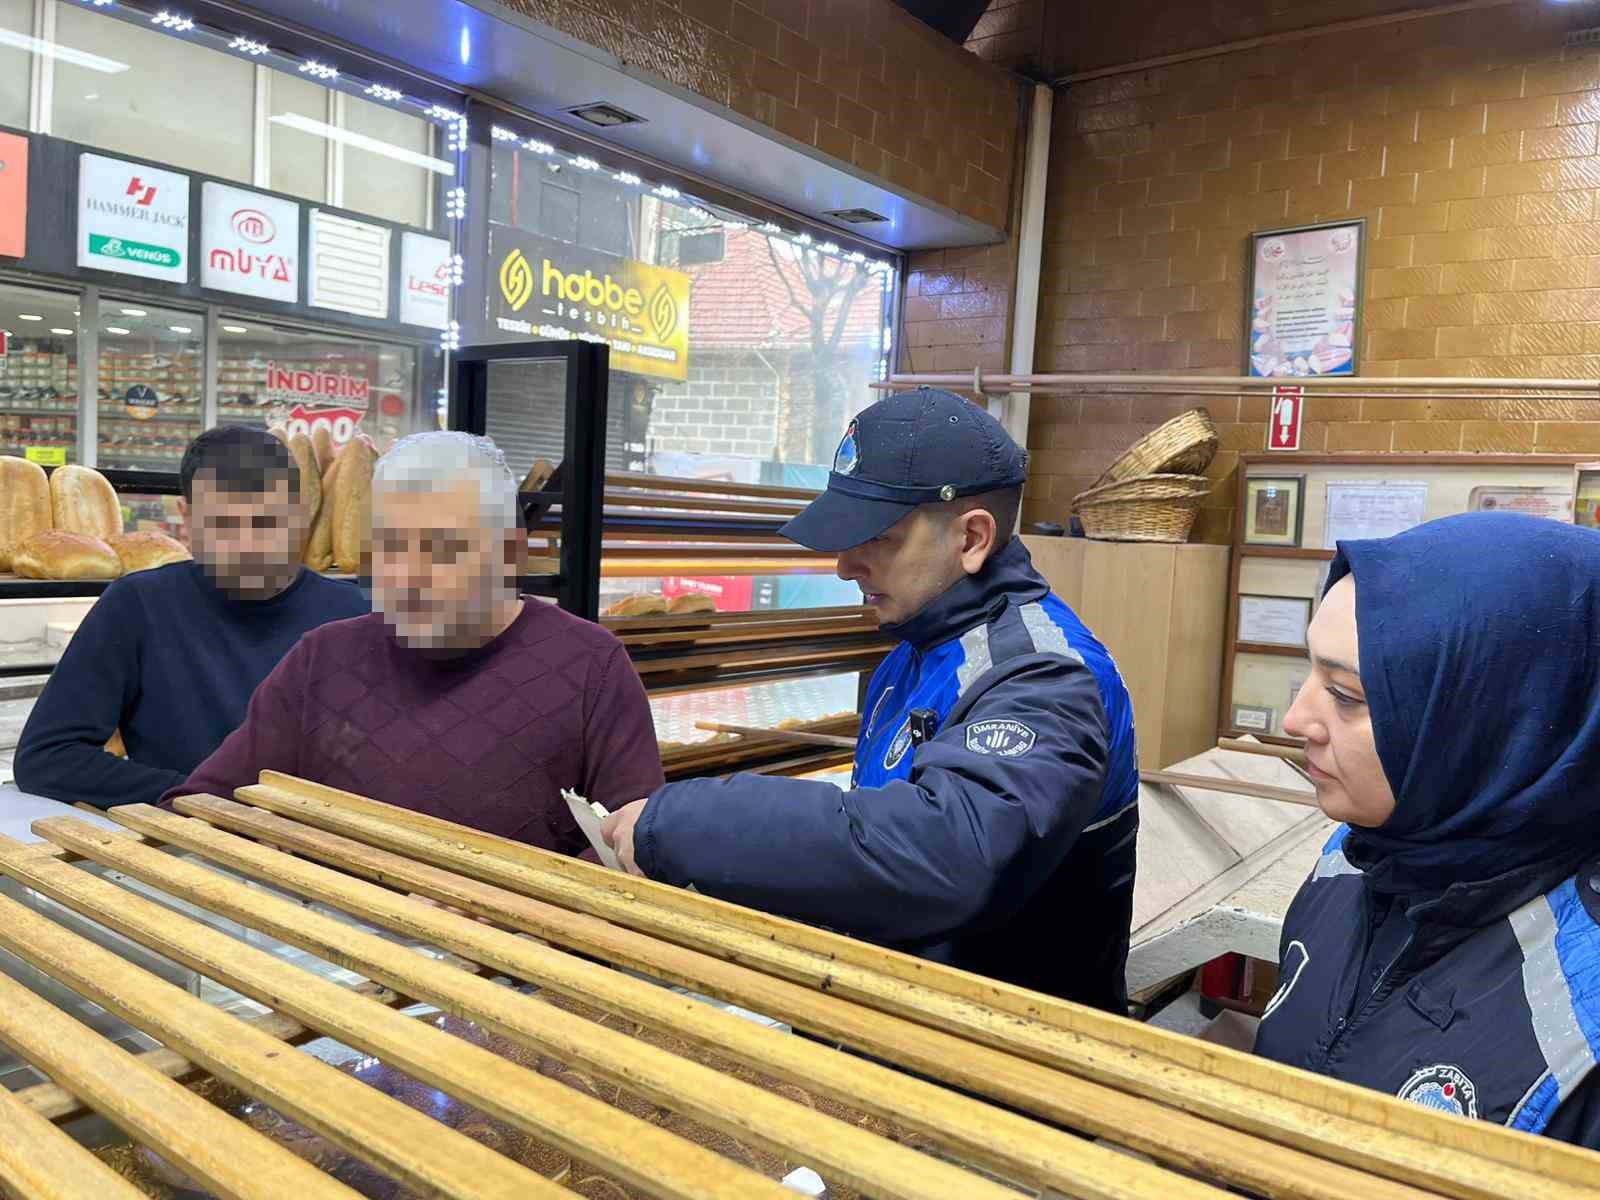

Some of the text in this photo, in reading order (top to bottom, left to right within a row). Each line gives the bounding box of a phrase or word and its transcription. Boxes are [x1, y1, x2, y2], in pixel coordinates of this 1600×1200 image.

[86, 197, 186, 229] HAMMER JACK
[266, 360, 369, 398] İNDİRİM
